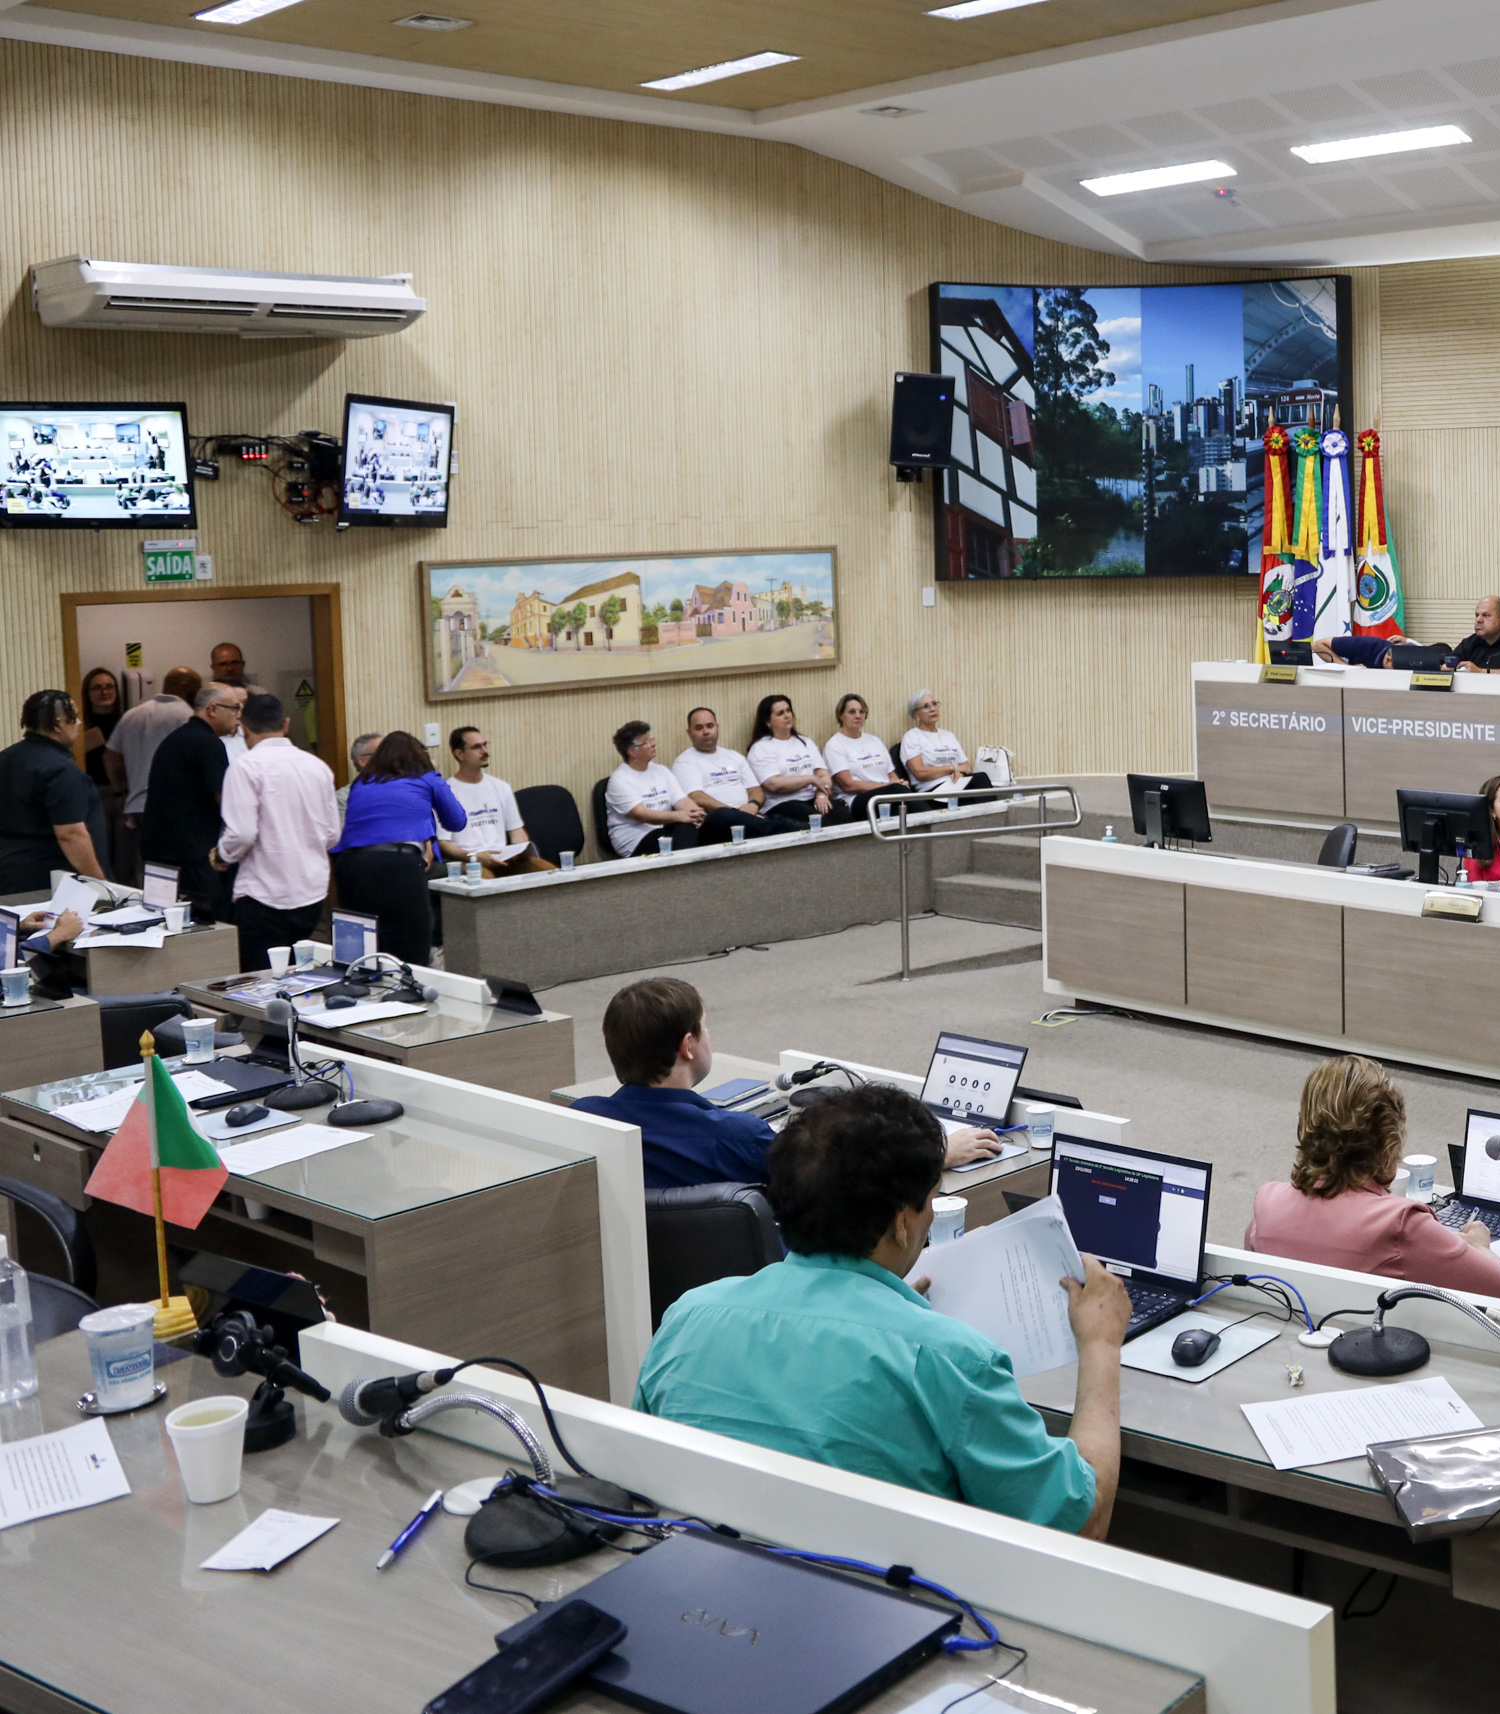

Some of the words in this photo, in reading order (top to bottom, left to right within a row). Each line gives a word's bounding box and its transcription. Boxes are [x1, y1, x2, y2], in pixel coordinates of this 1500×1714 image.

[146, 552, 192, 576] SAÍDA
[1229, 711, 1327, 732] SECRETÁRIO
[1351, 716, 1496, 741] VICE-PRESIDENTE
